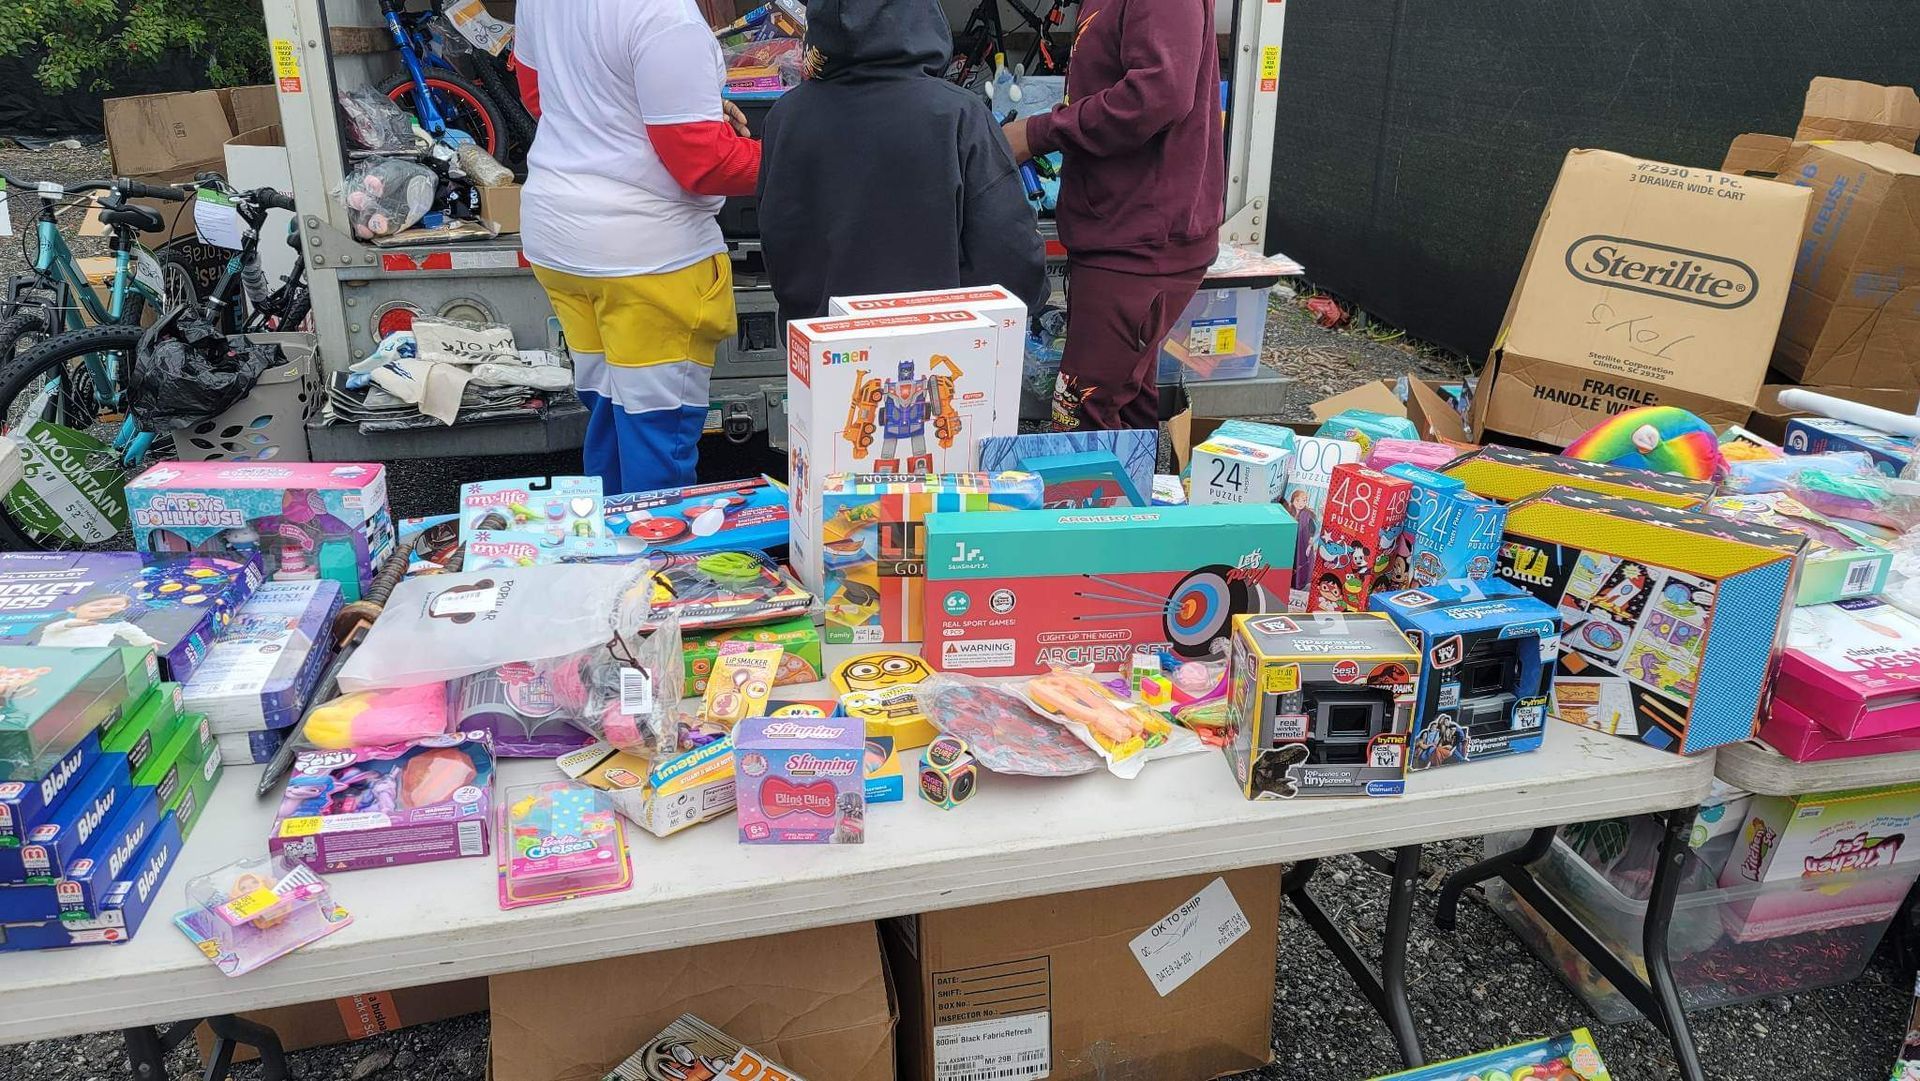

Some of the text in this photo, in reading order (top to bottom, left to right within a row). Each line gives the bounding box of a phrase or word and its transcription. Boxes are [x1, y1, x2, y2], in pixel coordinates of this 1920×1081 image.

[1636, 163, 1689, 179] #2930
[1706, 174, 1713, 184] 1
[1719, 176, 1743, 189] Pc.
[1629, 174, 1746, 201] 3 DRAWER WIDE CART
[857, 299, 899, 309] DIY
[1003, 319, 1016, 328] 3+
[454, 337, 515, 353] TO MY
[974, 339, 988, 349] 3+
[823, 350, 869, 366] Snaen
[1588, 351, 1674, 375] Sterilite Corporation
[1593, 360, 1666, 381] Clinton, SC 29325
[1533, 385, 1601, 412] HANDLE
[1582, 378, 1659, 407] FRAGILE:
[34, 429, 122, 518] MOUNTAIN
[862, 474, 881, 483] ON
[1210, 458, 1242, 493] 24
[1209, 488, 1243, 503] PUZZLE
[1332, 477, 1372, 523] 48
[151, 496, 225, 512] GABBY'S
[1386, 489, 1406, 515] 48
[136, 510, 243, 526] DOLLHOUSE
[1058, 513, 1160, 523] ARCHERY SET
[1331, 513, 1366, 534] PUZZLE
[1417, 498, 1452, 542] 24
[1469, 513, 1498, 543] 24
[1468, 542, 1495, 550] PUZZLE
[947, 596, 967, 607] 6+
[1541, 624, 1550, 633] 4
[1042, 630, 1126, 642] LIGHT-UP THE NIGHT!
[960, 643, 1013, 652] WARNING:
[1294, 642, 1329, 652] tiny
[1036, 645, 1130, 665] ARCHERY
[737, 657, 768, 666] SMACKER
[1332, 666, 1356, 675] best
[1393, 684, 1414, 694] PARK
[1280, 719, 1298, 727] real
[1521, 717, 1536, 728] tv!
[763, 723, 845, 738] Shinning
[934, 747, 953, 758] CUBE
[786, 754, 857, 775] Shinning
[1378, 756, 1395, 766] tv!
[922, 780, 942, 794] CUBE
[1304, 776, 1325, 787] tiny
[462, 787, 476, 795] 20
[775, 793, 830, 806] Bling Bling
[750, 825, 764, 834] 6+
[541, 835, 578, 847] Barbie
[528, 841, 593, 858] Chelsea
[1151, 896, 1201, 938] OK TO SHIP
[937, 977, 960, 985] DATE:
[937, 989, 962, 998] SHIFT:
[938, 1002, 956, 1010] BOX
[371, 1002, 388, 1031] busloa
[939, 1011, 981, 1022] INSPECTOR
[961, 1035, 981, 1043] Black
[998, 1055, 1012, 1063] 29B
